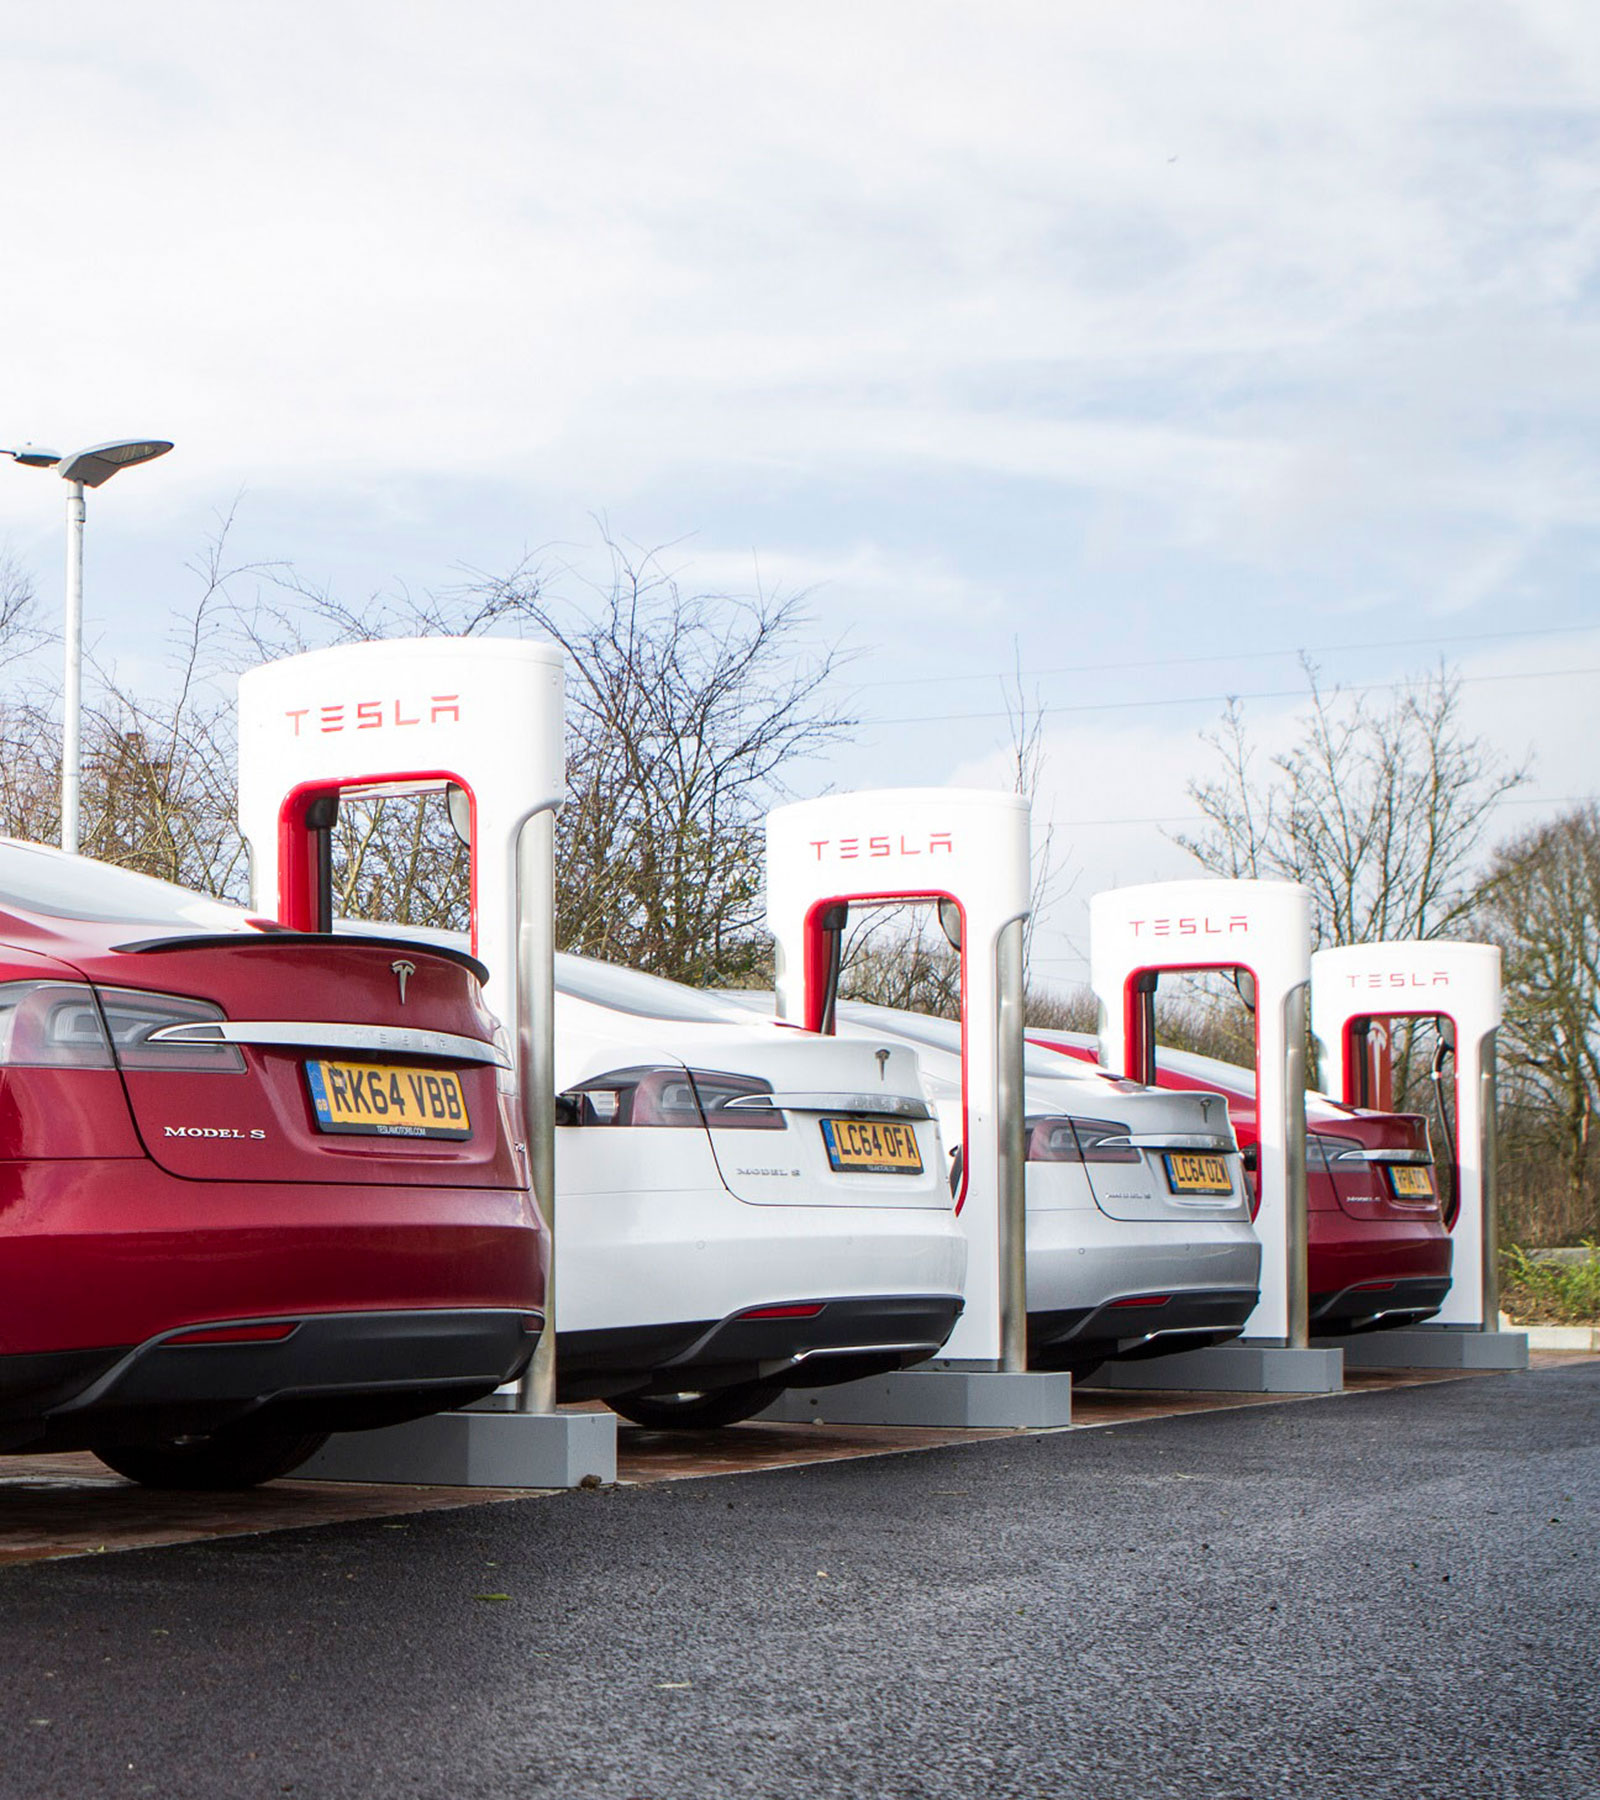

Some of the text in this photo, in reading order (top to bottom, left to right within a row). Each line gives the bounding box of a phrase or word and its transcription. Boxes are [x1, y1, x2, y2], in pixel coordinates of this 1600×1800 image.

[285, 694, 460, 737] TESLA
[809, 832, 953, 861] TESLA
[1128, 915, 1249, 937] TESLA
[1346, 971, 1450, 989] TESLA
[328, 1067, 462, 1120] RK64 VBB
[163, 1126, 266, 1140] MODEL S
[835, 1123, 917, 1159] LC64 OFA
[1173, 1157, 1207, 1183] LC64
